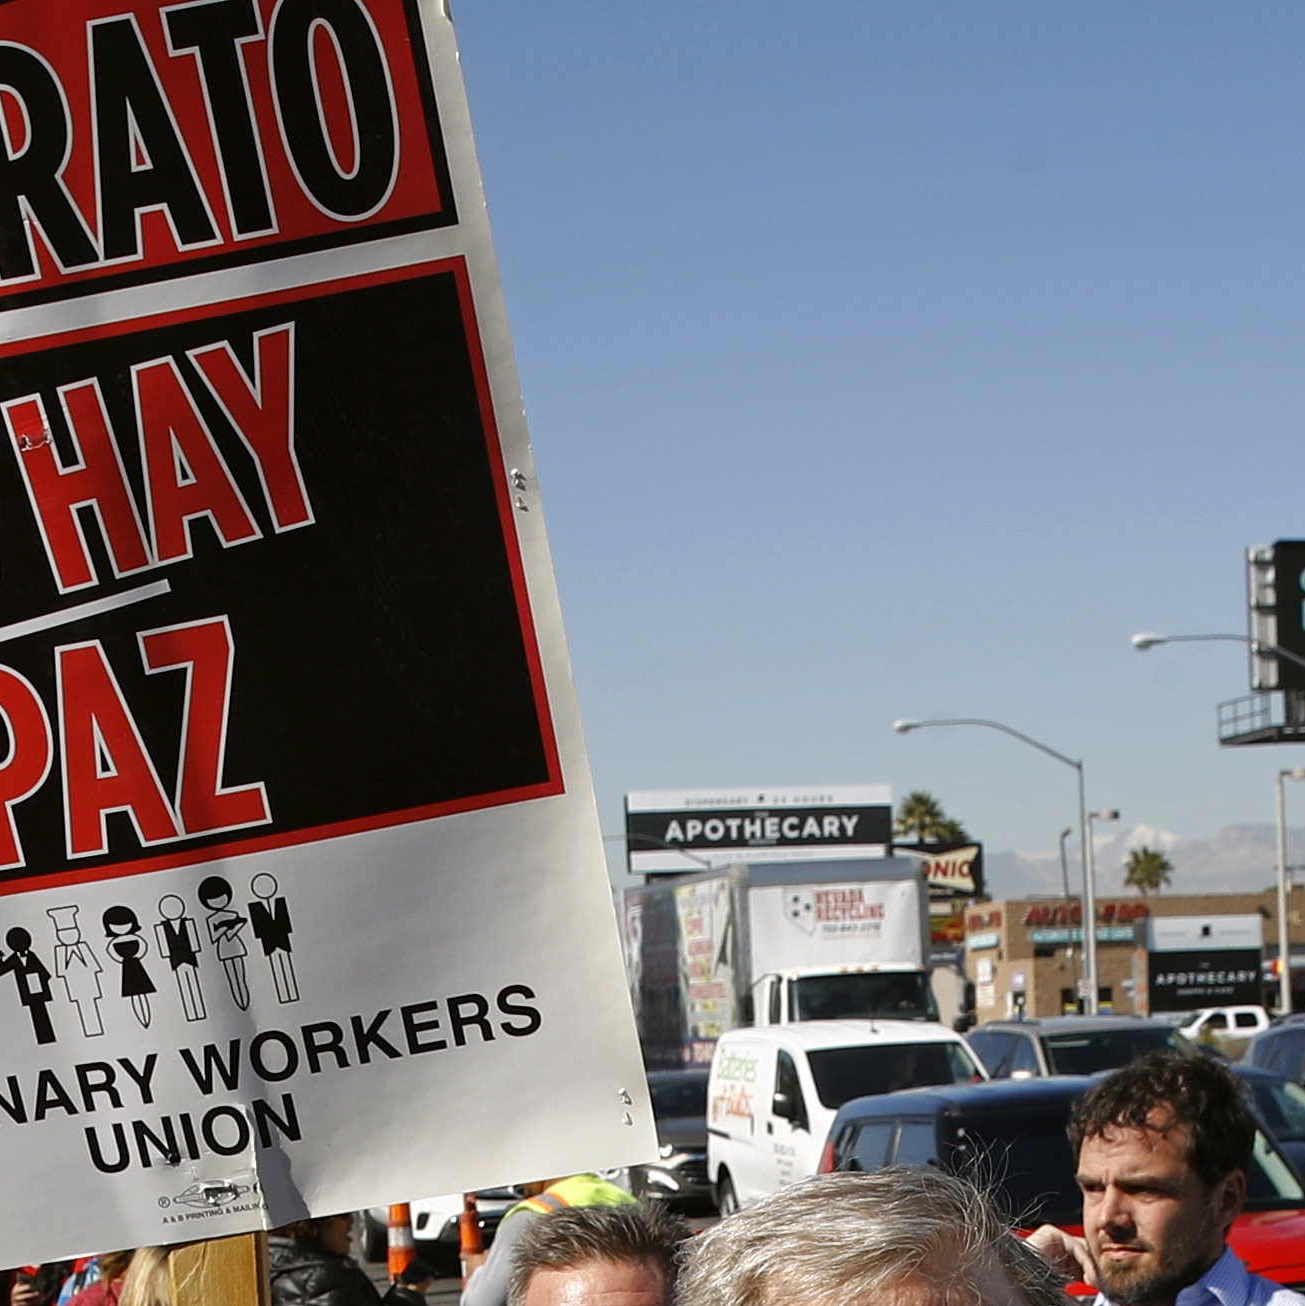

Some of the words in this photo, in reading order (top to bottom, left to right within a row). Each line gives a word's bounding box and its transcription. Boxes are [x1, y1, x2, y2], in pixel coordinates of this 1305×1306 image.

[0, 321, 316, 595] HAY
[664, 814, 860, 842] APOTHECARY
[179, 984, 543, 1093] WORKERS
[85, 1094, 302, 1175] UNION
